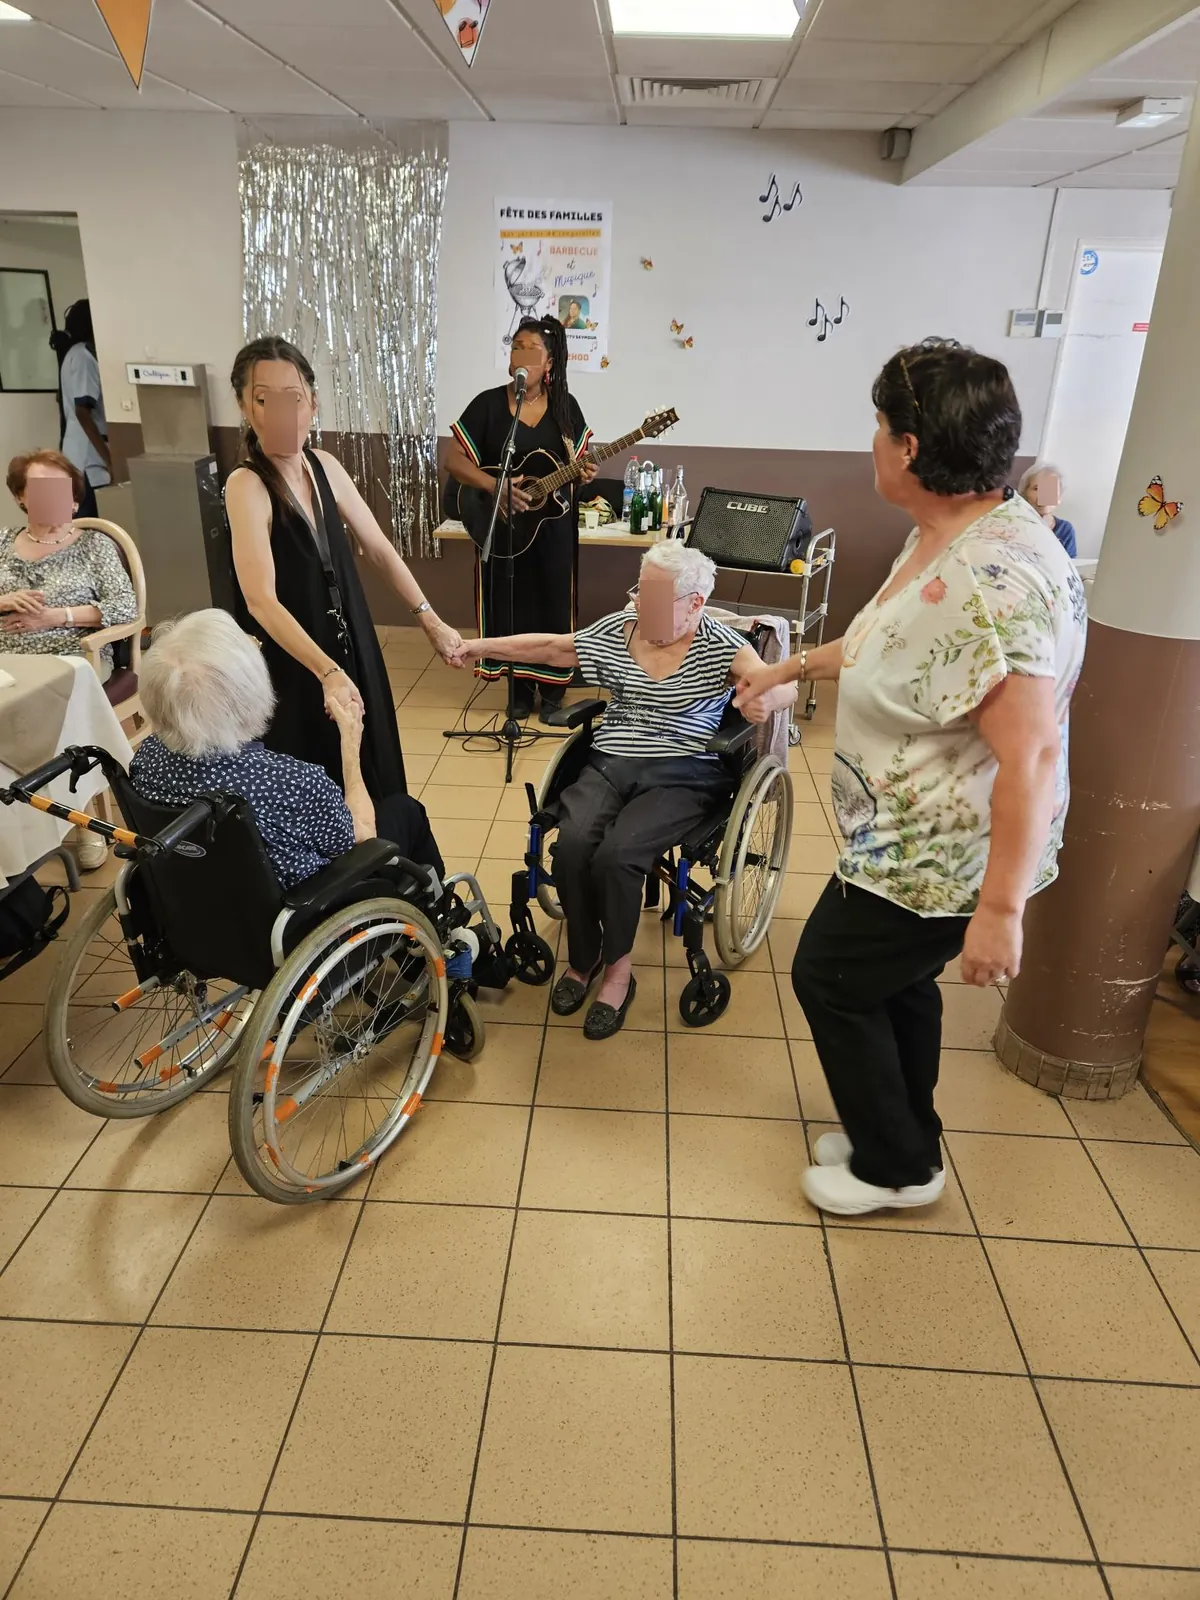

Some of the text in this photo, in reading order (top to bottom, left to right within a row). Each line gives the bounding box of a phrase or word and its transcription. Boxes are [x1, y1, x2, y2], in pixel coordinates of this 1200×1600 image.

[500, 206, 602, 222] FÊTE DES FAMILLES
[566, 258, 576, 270] et
[726, 502, 768, 514] CUBE
